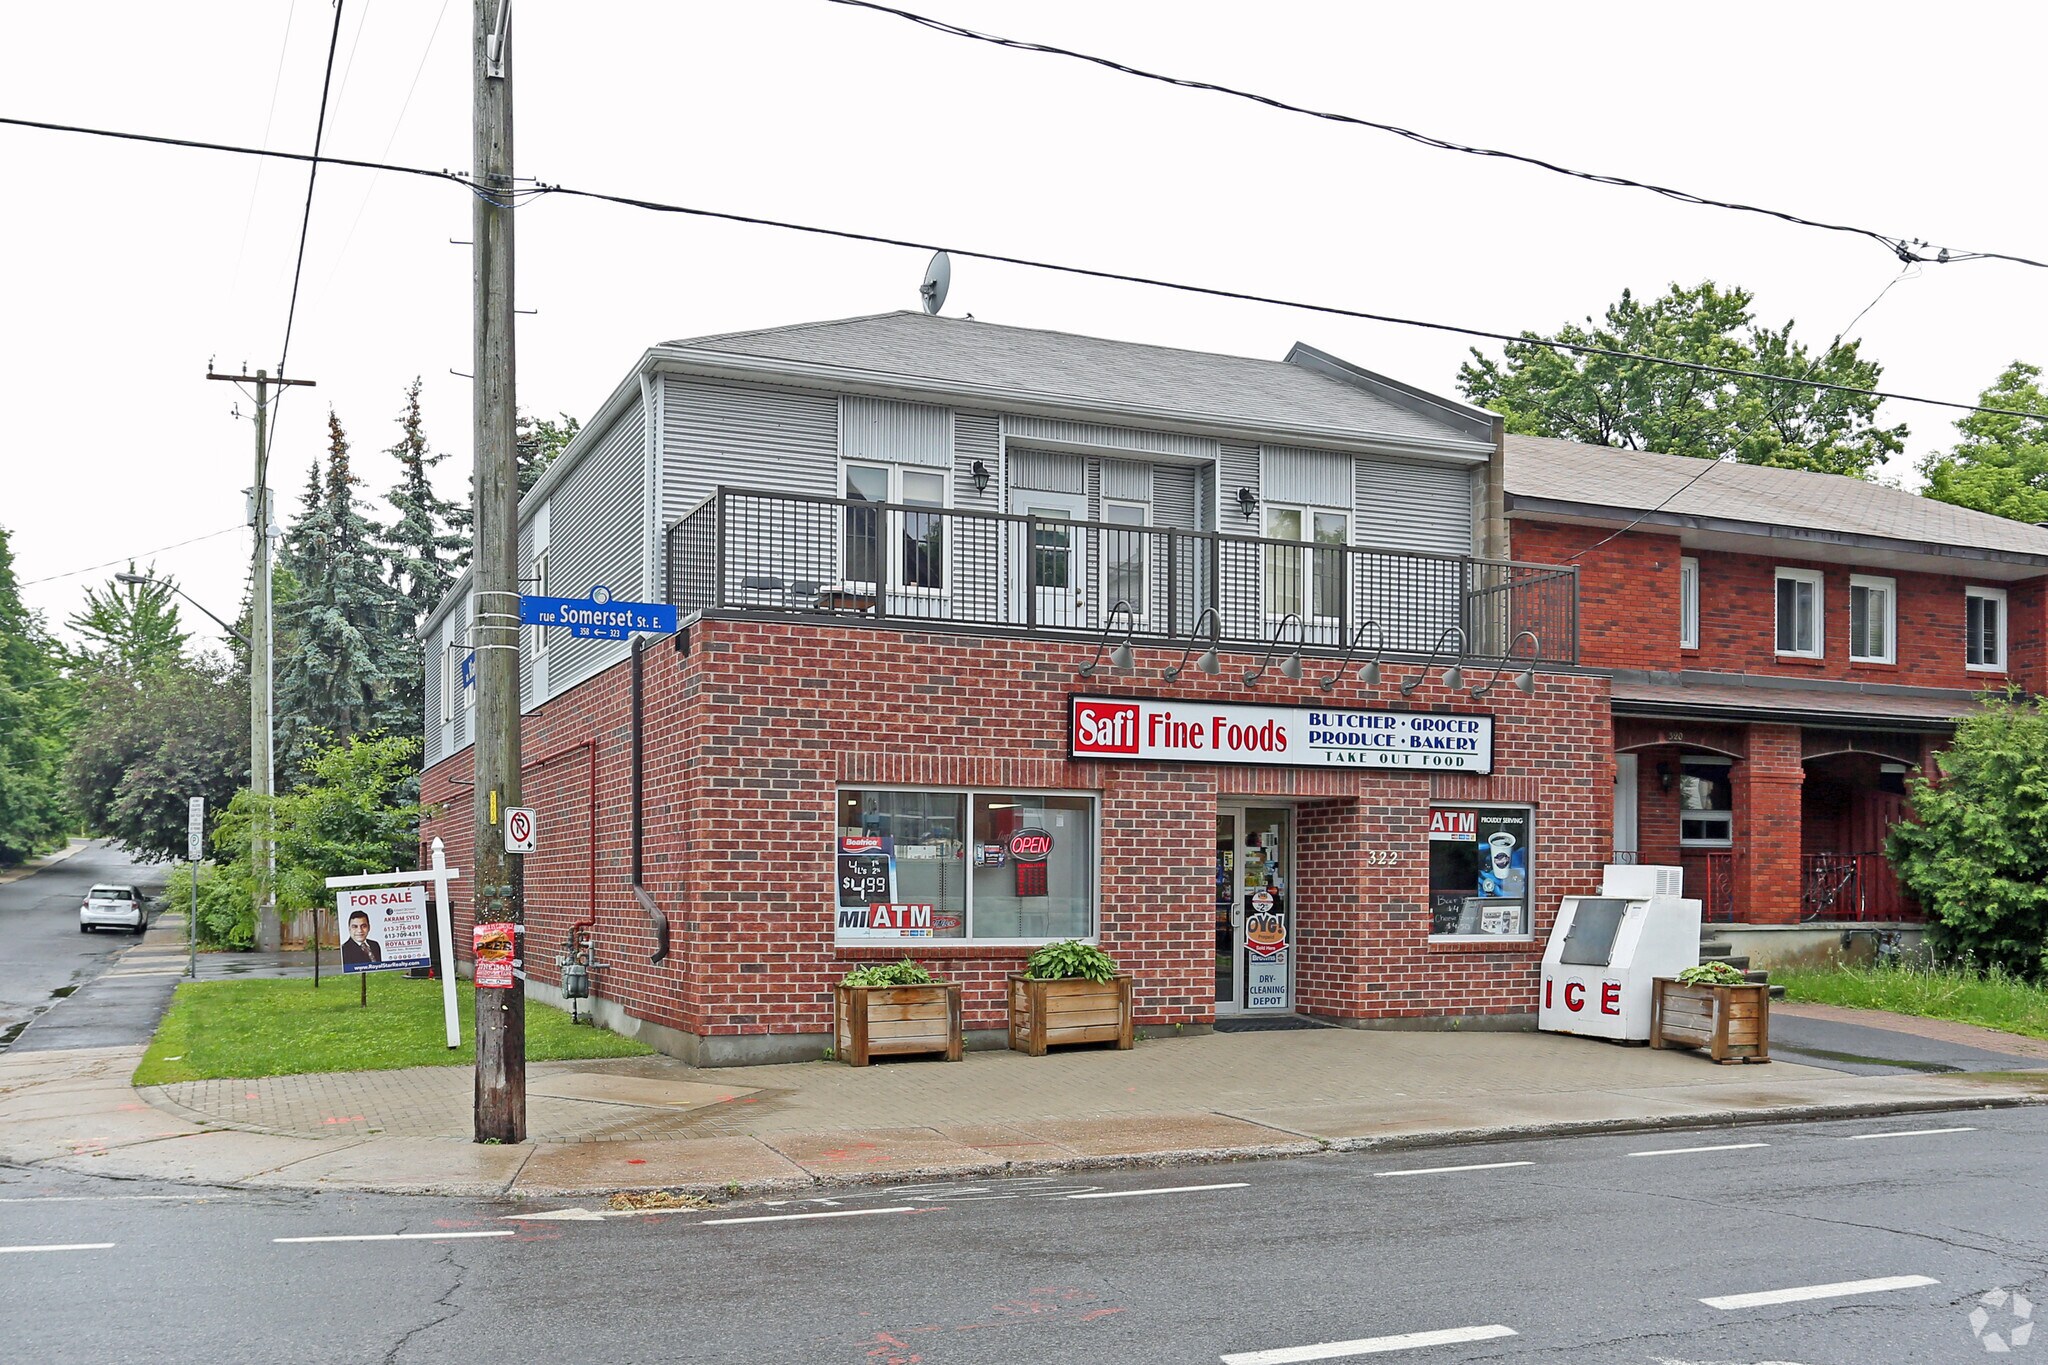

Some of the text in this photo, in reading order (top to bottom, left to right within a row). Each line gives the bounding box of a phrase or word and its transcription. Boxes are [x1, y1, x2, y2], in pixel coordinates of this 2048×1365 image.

[539, 605, 661, 628] rue Somerset St. E.
[579, 628, 590, 636] 358
[610, 629, 620, 637] 323
[1078, 708, 1287, 752] Safi Fine Foods
[1309, 712, 1479, 733] BUTCHER GROCER
[1309, 731, 1479, 750] PRODUCE BAKERY
[1325, 751, 1465, 767] TAKE OUT FOOD
[1430, 811, 1475, 832] ATM
[1481, 816, 1502, 824] PROUDLY
[1012, 837, 1050, 853] OPEN
[1368, 851, 1398, 866] 322
[351, 892, 412, 906] FOR SALE
[872, 905, 931, 927] ATM
[354, 960, 420, 971] www.RoyalStarRealty.com
[1259, 975, 1276, 983] DRY-
[1250, 985, 1285, 994] CLEANING
[1546, 975, 1621, 1015] ICE
[1253, 997, 1281, 1006] DEPOT
